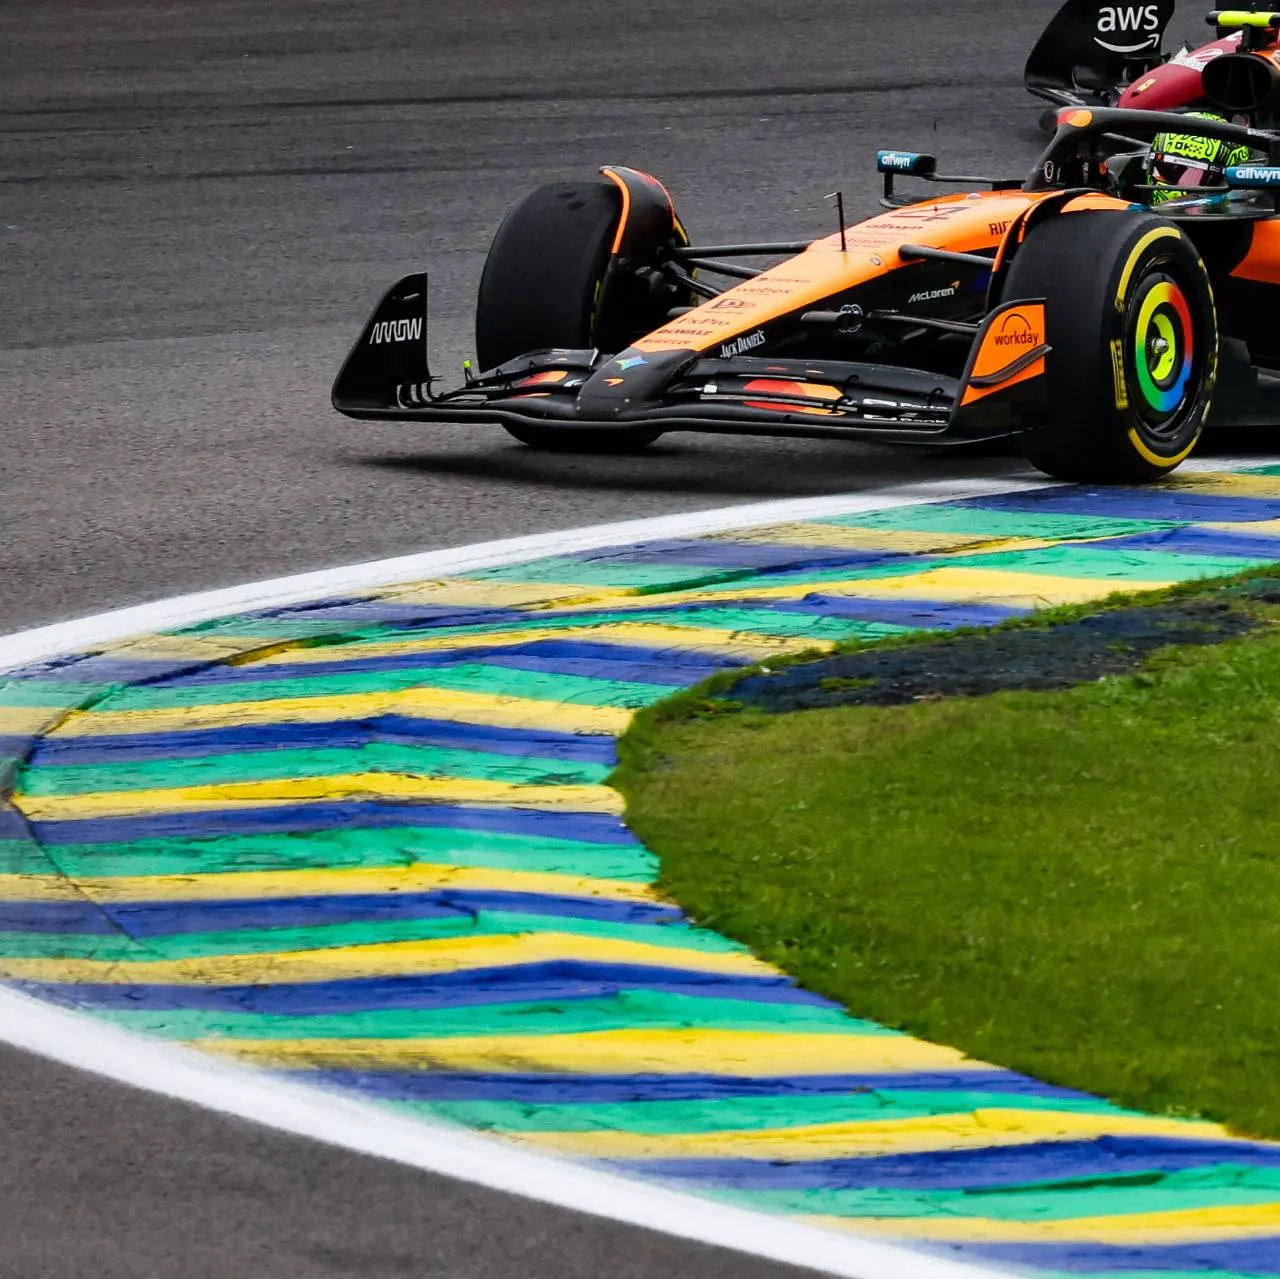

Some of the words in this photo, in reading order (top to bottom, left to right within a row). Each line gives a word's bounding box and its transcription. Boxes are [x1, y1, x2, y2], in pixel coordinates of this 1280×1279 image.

[1096, 3, 1160, 33] aws
[908, 286, 955, 303] McLaren
[994, 331, 1039, 348] workday
